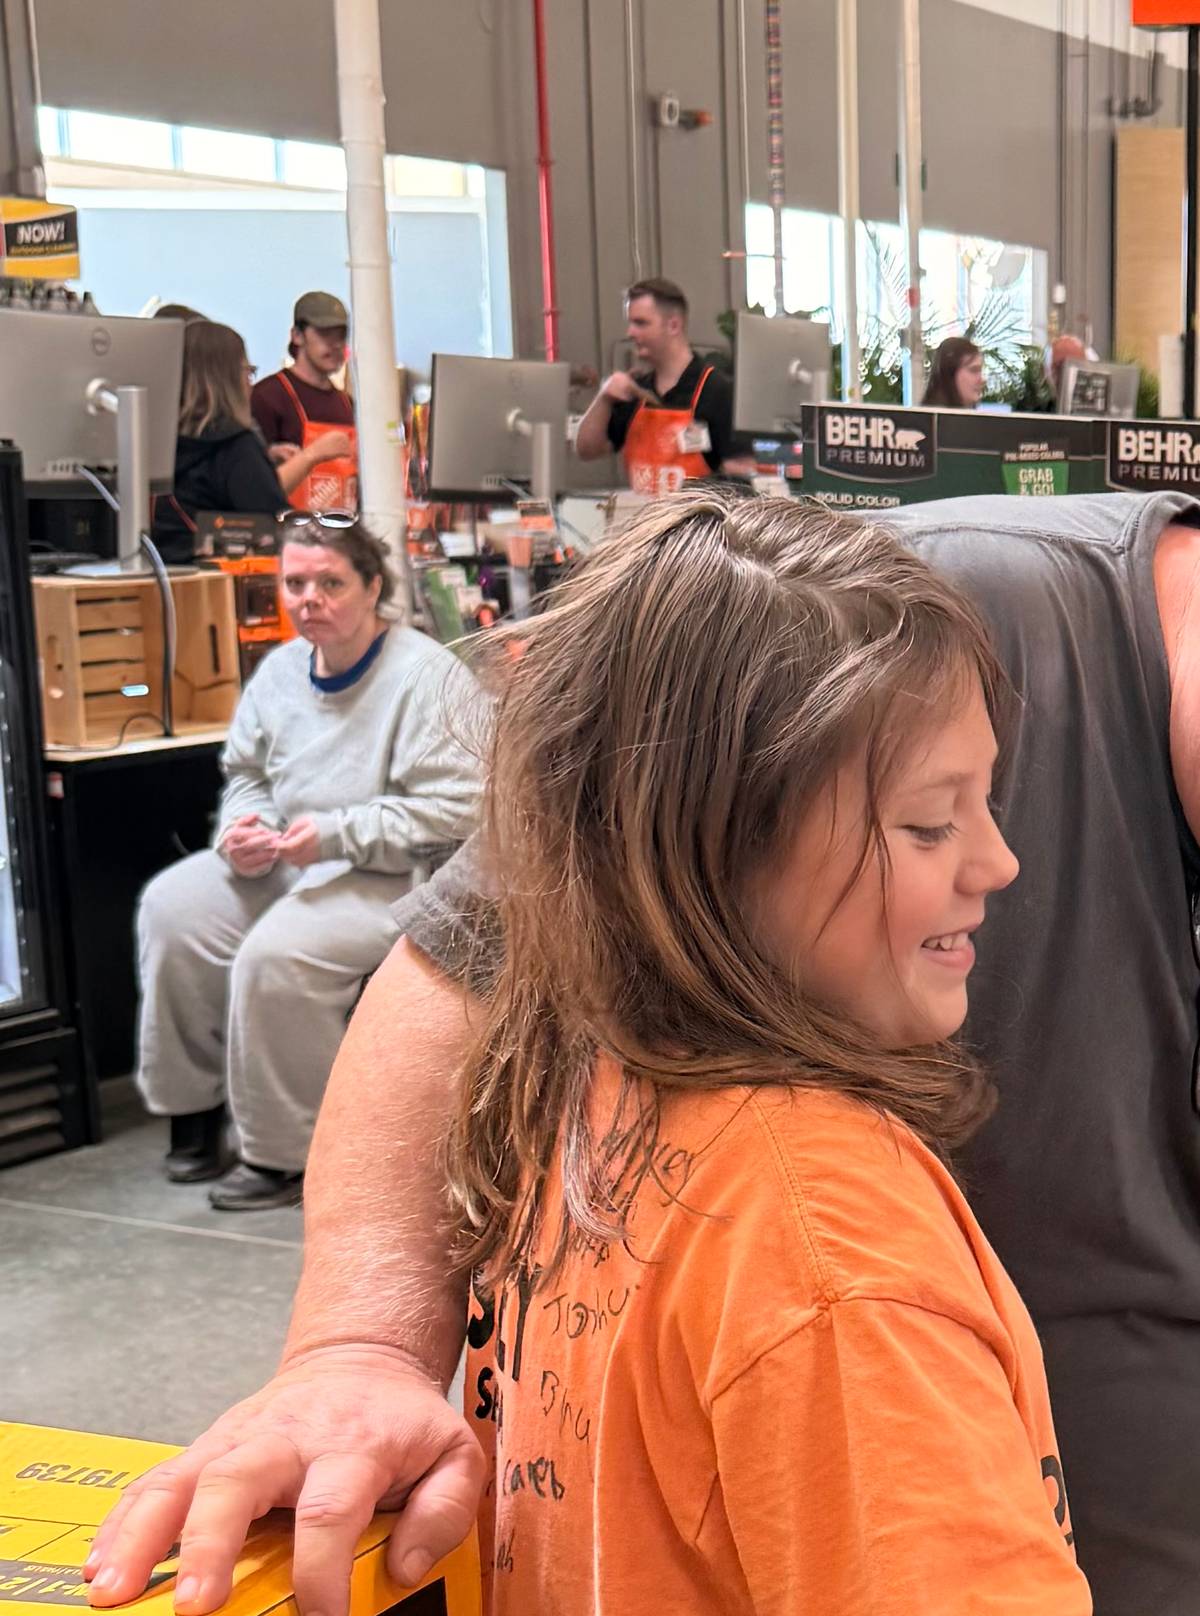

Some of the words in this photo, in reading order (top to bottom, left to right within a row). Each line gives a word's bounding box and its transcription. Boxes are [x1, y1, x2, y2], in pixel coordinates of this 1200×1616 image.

[17, 221, 65, 244] NOW!
[825, 414, 895, 449] BEHR
[1118, 429, 1193, 464] BEHR
[826, 449, 926, 468] PREMIUM
[1019, 467, 1054, 483] GRAB
[816, 492, 853, 505] SOLID
[855, 494, 901, 508] COLOR
